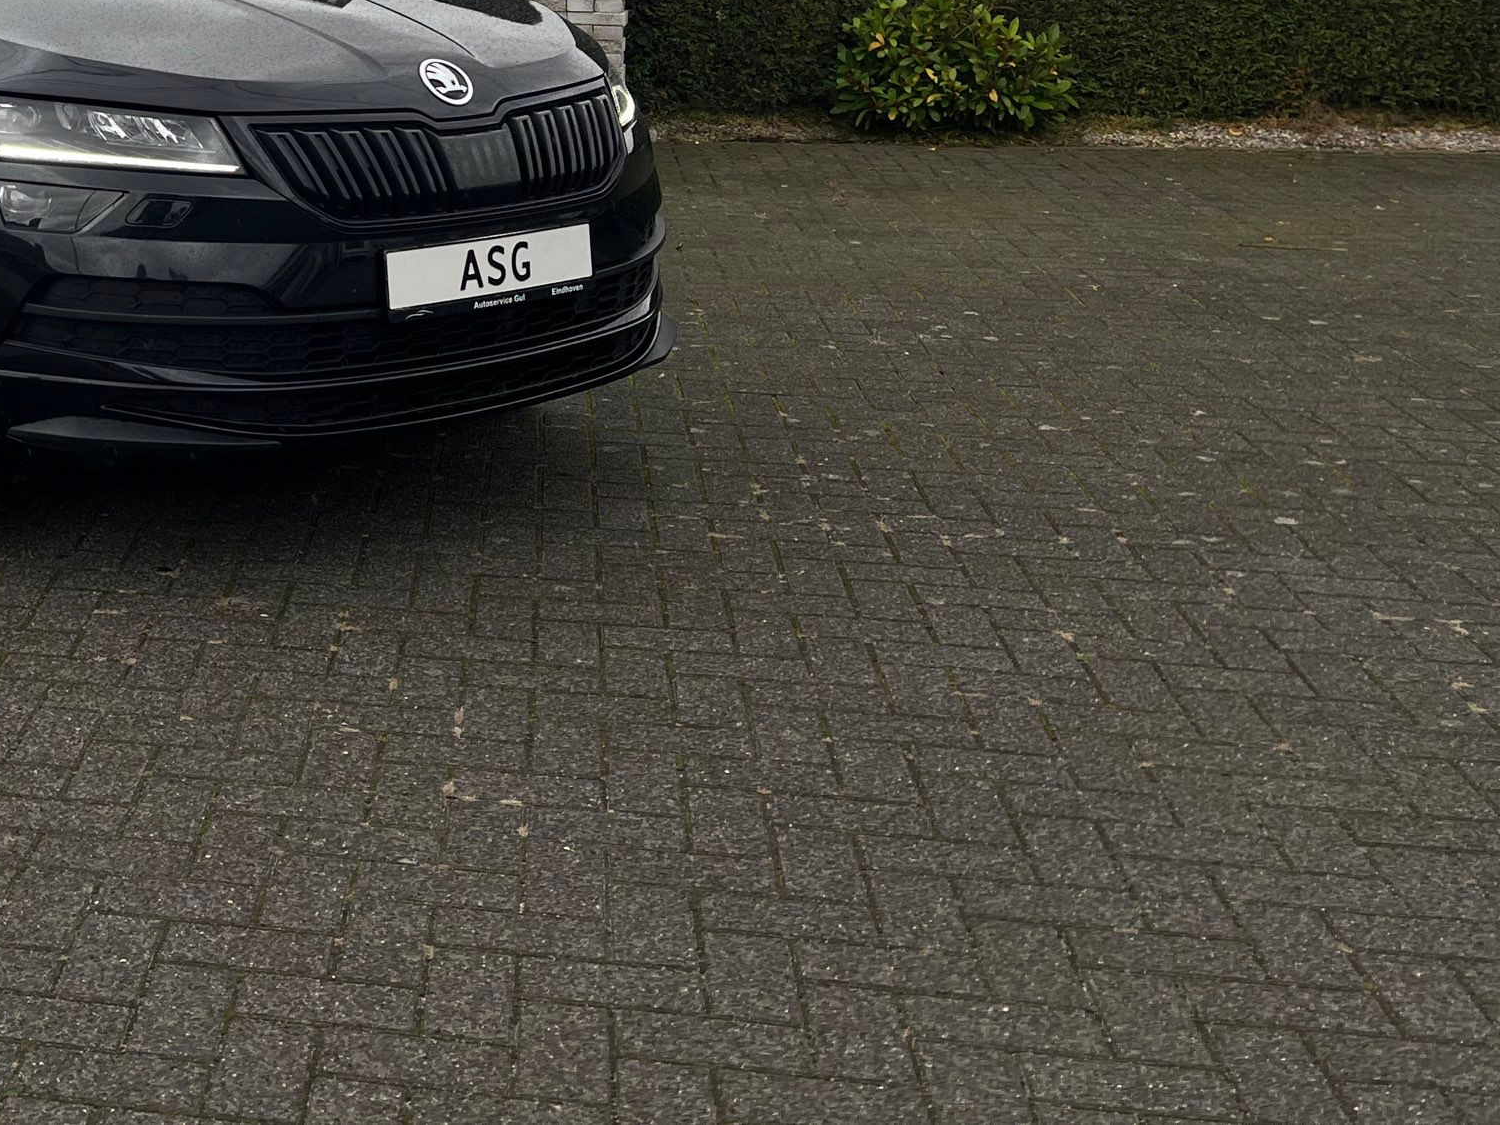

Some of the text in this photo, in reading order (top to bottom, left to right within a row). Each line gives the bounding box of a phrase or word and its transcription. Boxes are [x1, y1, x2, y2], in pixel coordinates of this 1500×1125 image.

[460, 241, 531, 291] ASG
[551, 283, 584, 296] Eindhoven
[473, 293, 526, 310] Autoservice Gul
